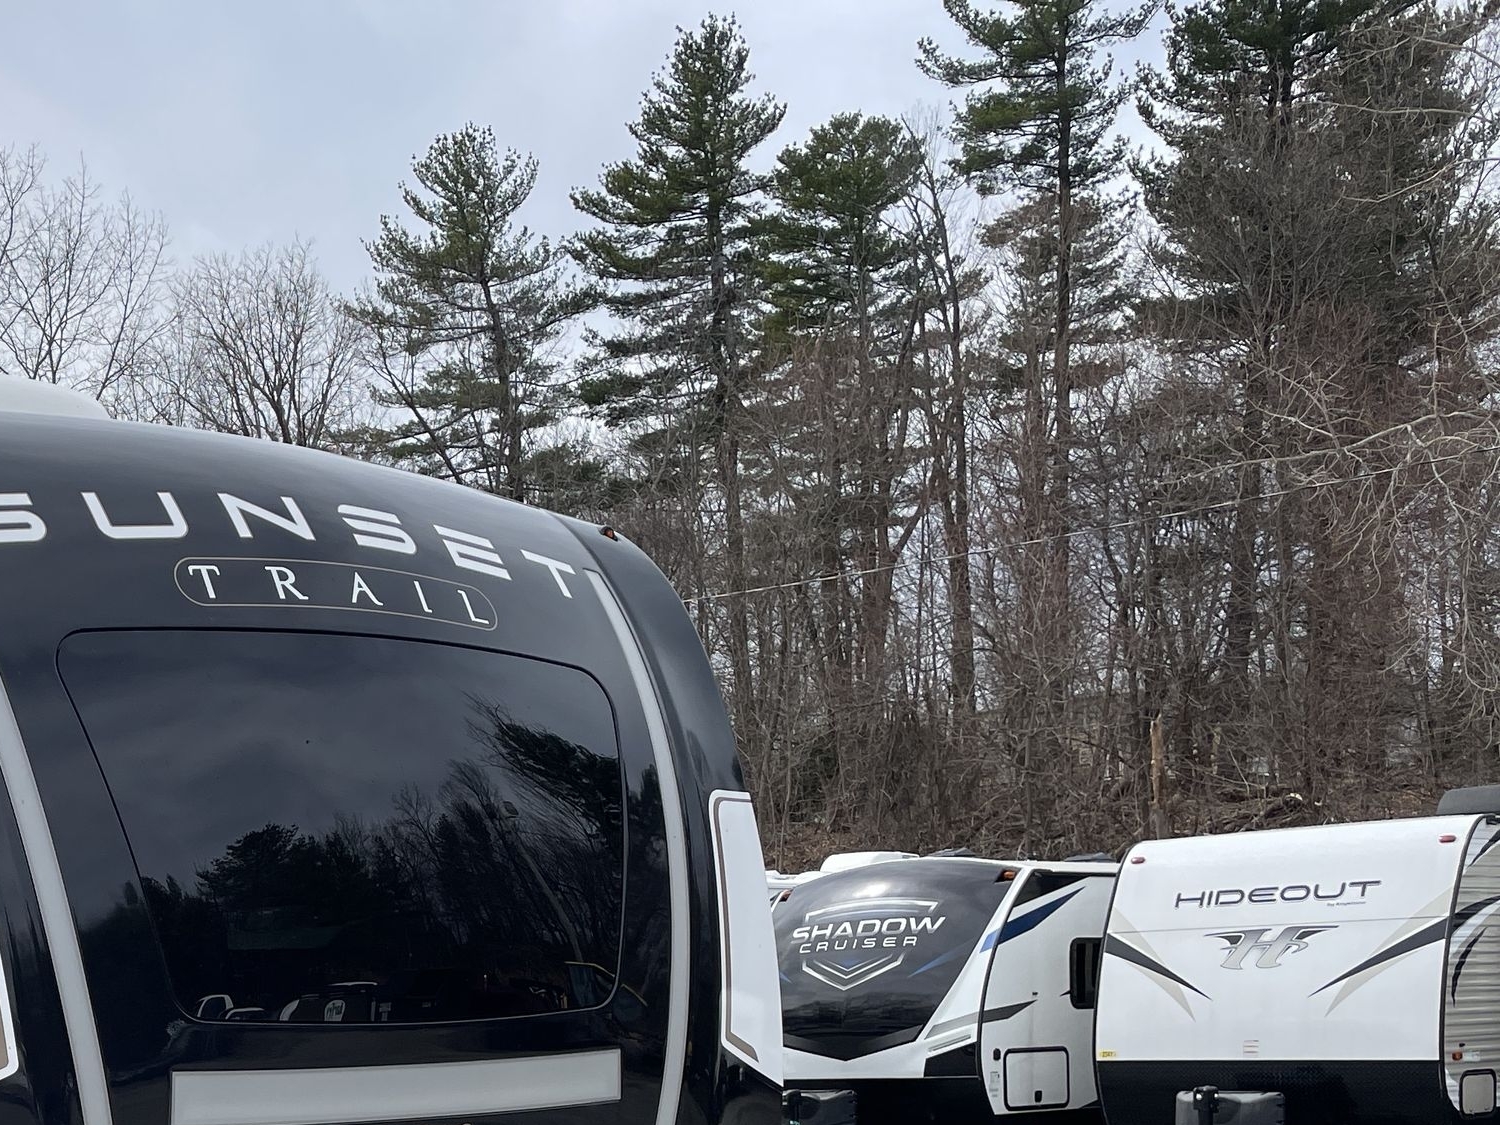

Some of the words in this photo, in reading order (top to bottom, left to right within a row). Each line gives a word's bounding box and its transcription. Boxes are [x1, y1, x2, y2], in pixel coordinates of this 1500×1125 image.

[188, 564, 490, 625] TRAIL
[1174, 880, 1382, 909] HIDEOUT
[791, 916, 946, 945] SHADOW
[800, 936, 918, 954] CRUISER
